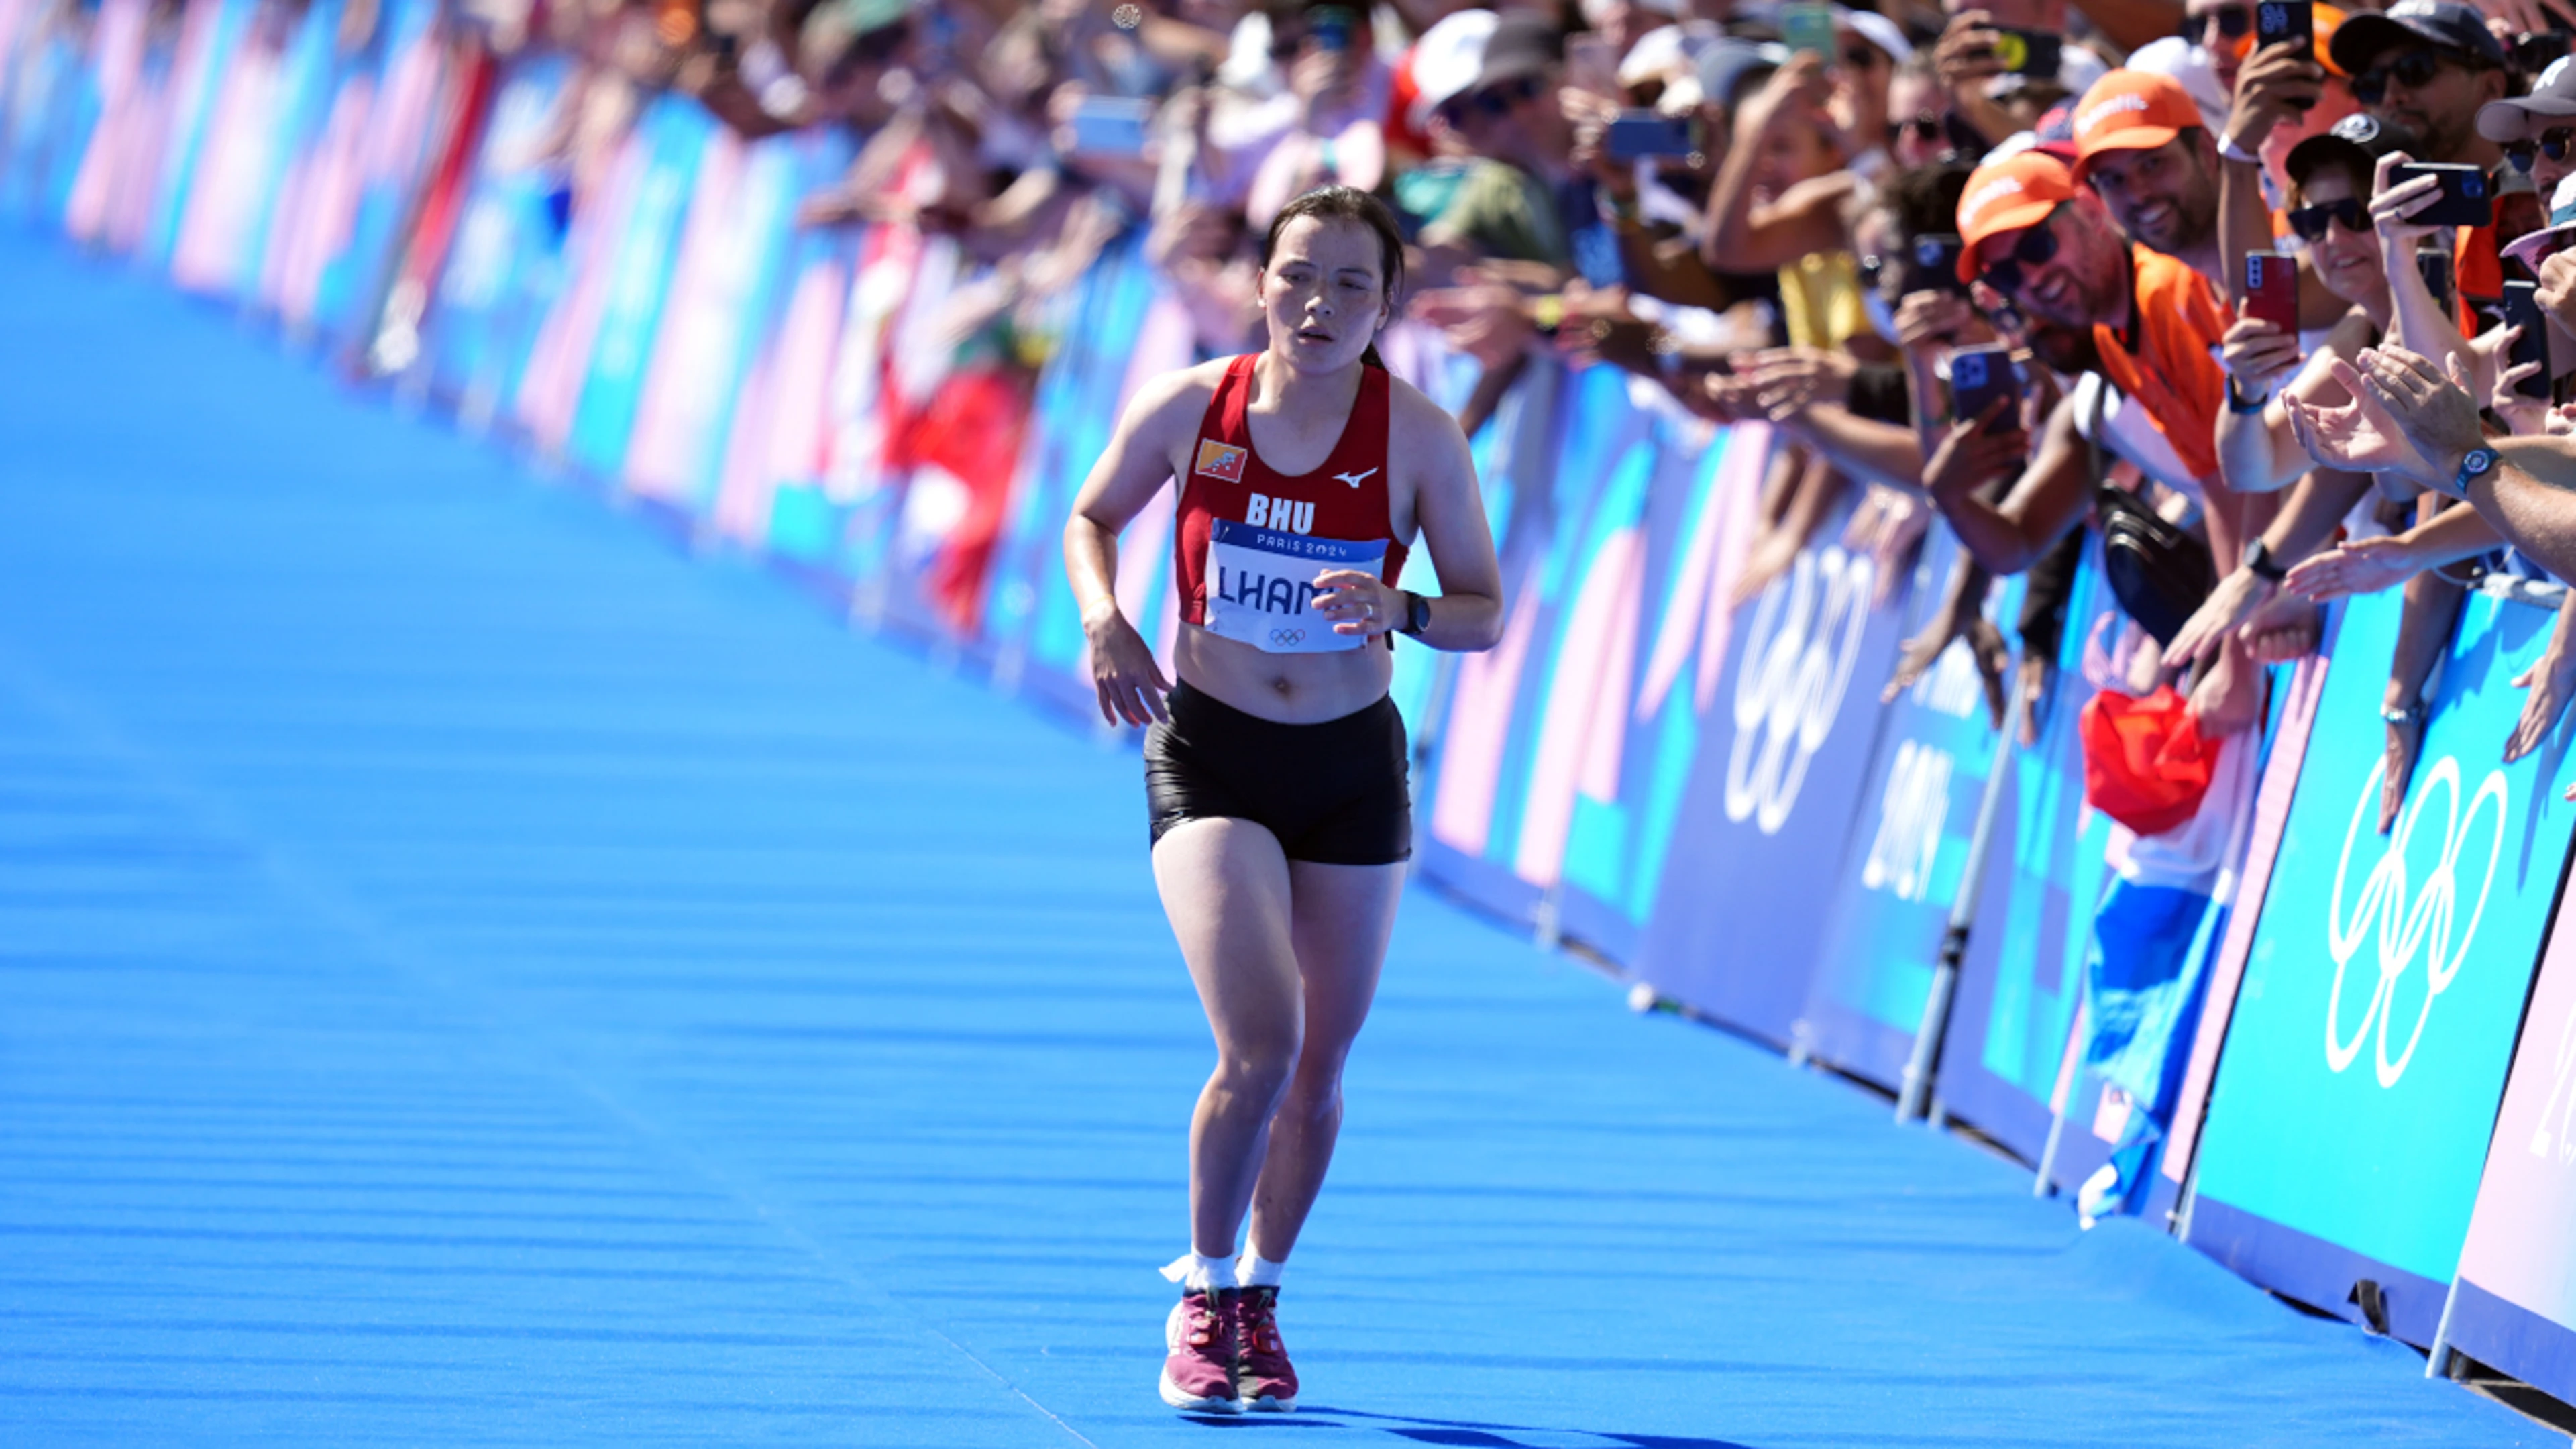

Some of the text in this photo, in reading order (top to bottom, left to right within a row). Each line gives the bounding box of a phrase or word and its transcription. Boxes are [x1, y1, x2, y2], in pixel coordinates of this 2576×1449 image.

[1246, 492, 1316, 535] BHU
[1257, 535, 1347, 556] PARIS 2024
